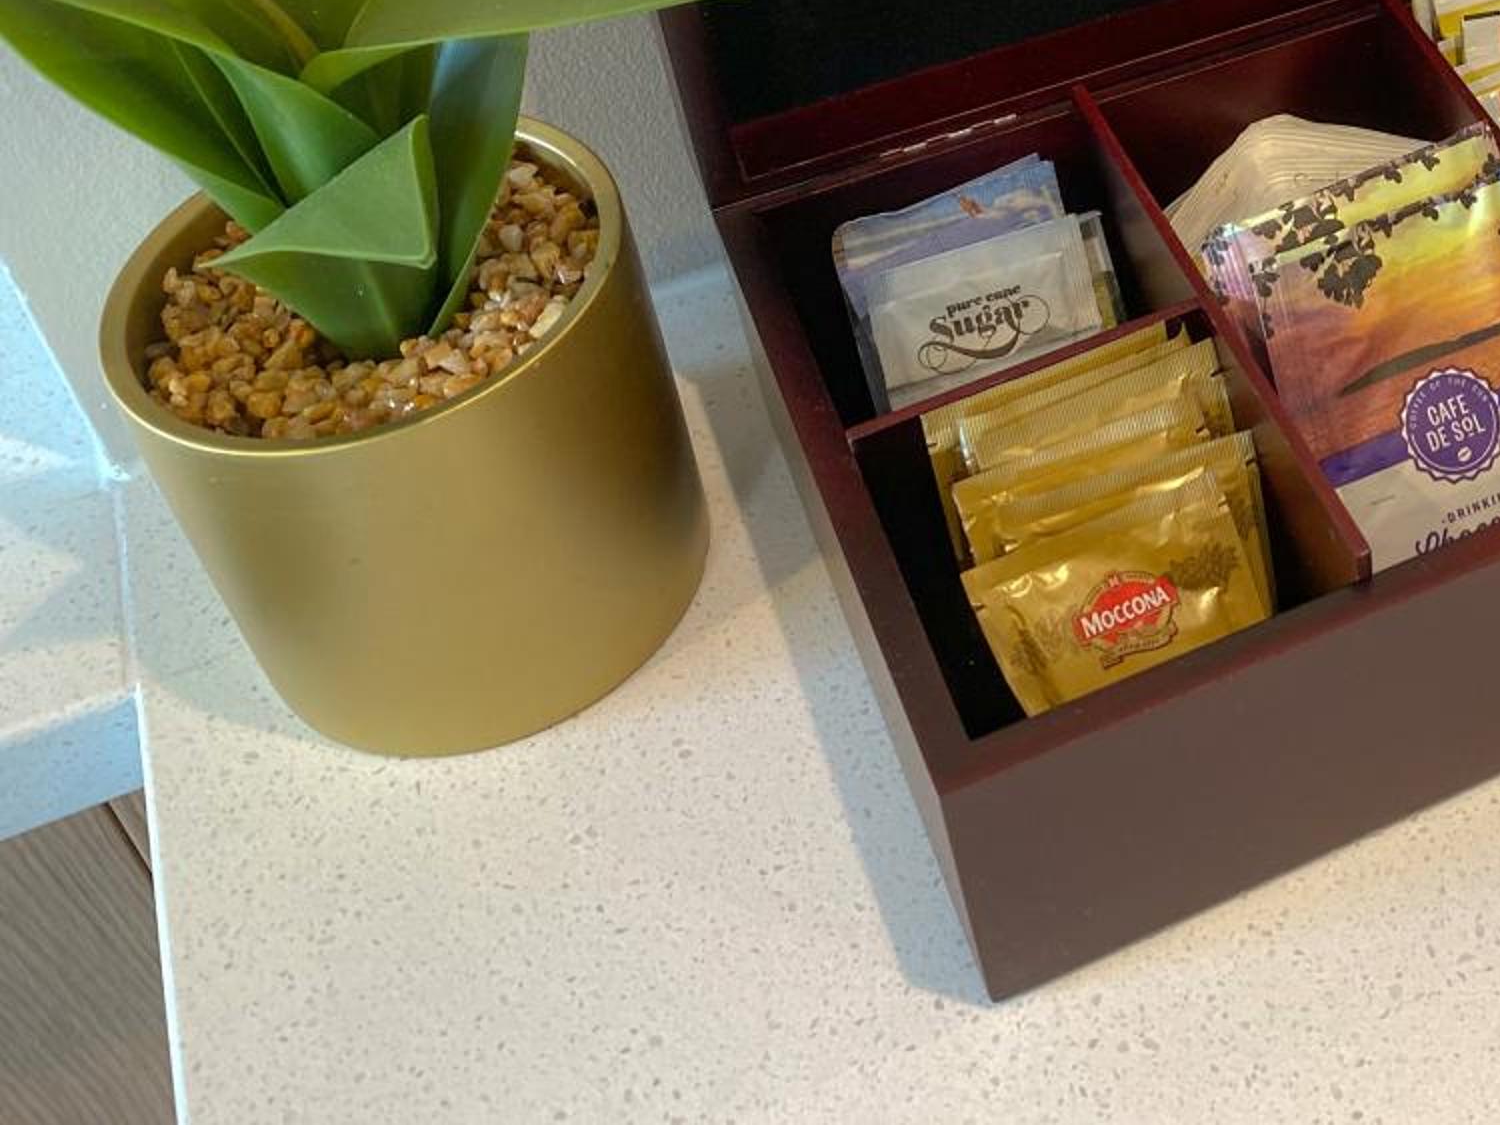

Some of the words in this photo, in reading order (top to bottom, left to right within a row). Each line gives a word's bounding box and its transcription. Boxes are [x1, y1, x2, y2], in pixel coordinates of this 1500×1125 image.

[946, 296, 982, 318] pure
[985, 284, 1021, 302] cane
[919, 295, 1044, 365] Sugar
[1426, 393, 1470, 427] CAFE
[1425, 426, 1451, 453] DE
[1450, 413, 1487, 443] SOL
